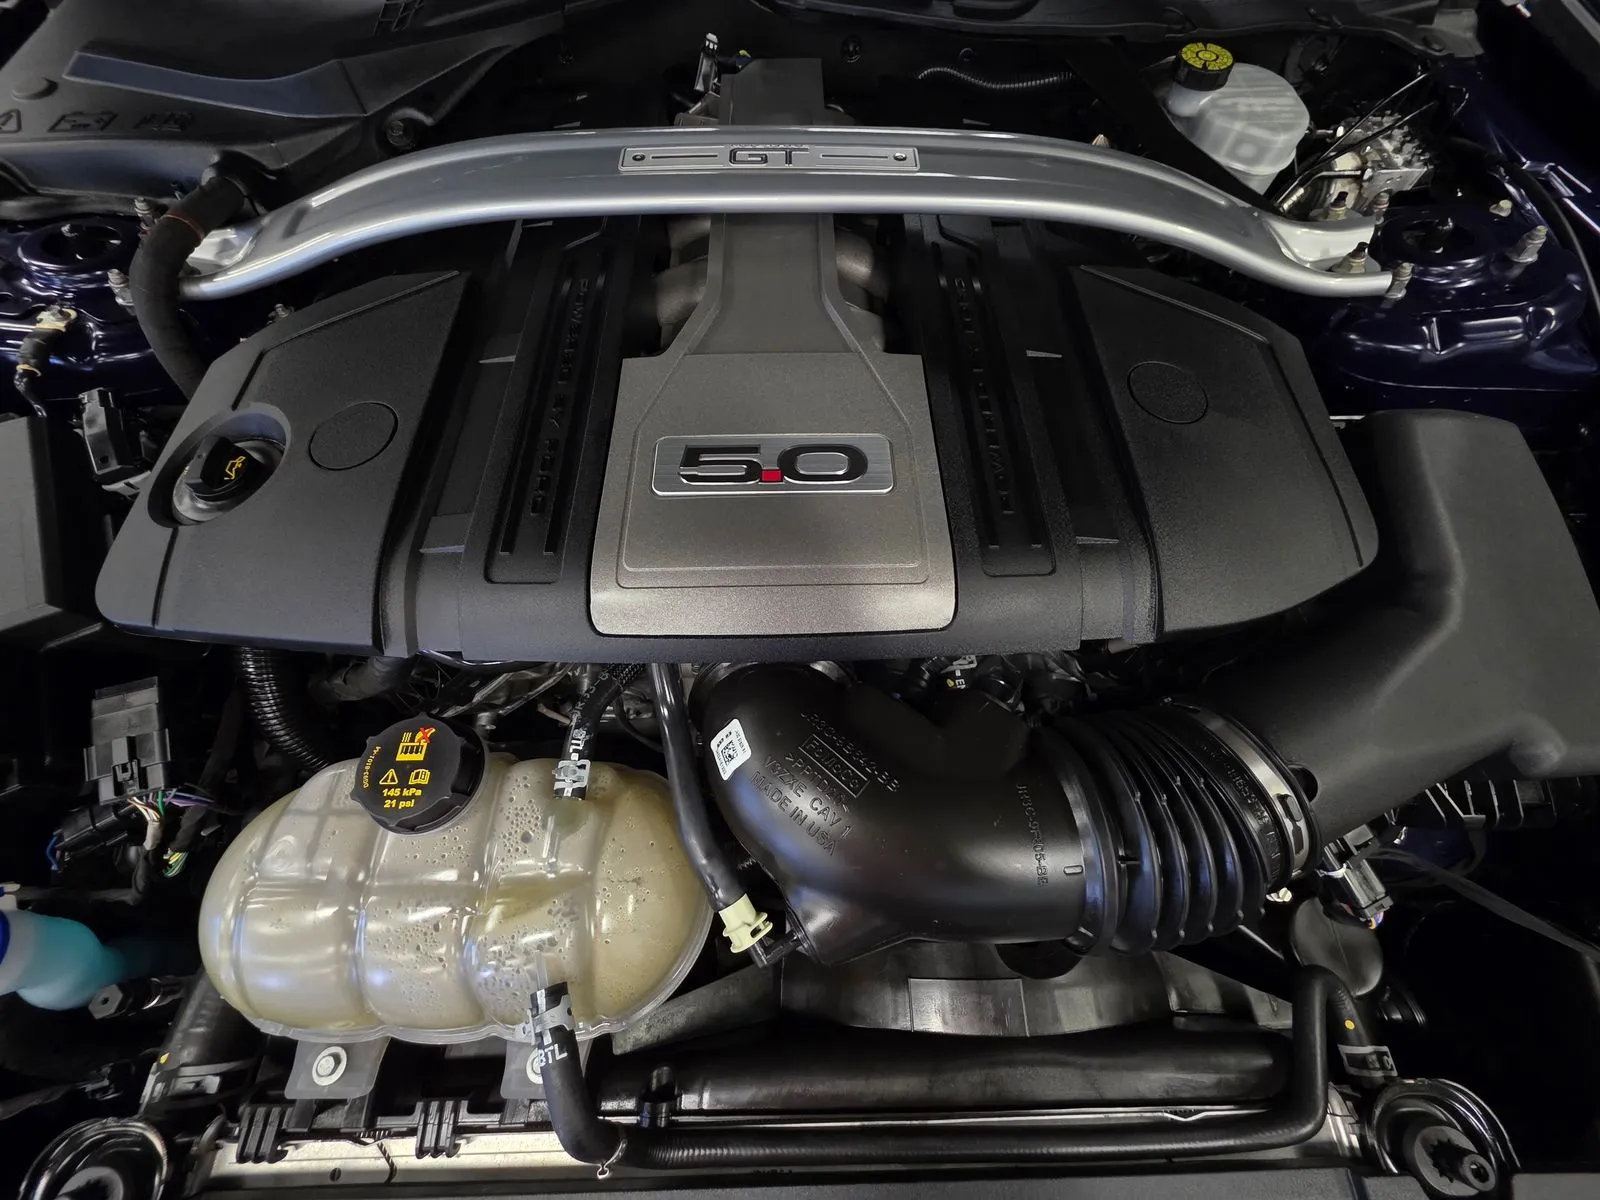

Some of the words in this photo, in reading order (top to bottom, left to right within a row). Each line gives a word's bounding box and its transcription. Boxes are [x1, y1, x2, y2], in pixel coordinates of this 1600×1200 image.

[729, 147, 809, 167] GT
[678, 444, 868, 485] 5.0
[382, 787, 401, 797] 145
[402, 787, 423, 797] kPa
[383, 799, 397, 808] 21
[398, 798, 415, 810] psi
[751, 770, 793, 813] MADE
[788, 806, 809, 828] IN
[806, 820, 838, 857] USA
[809, 796, 842, 827] CAV
